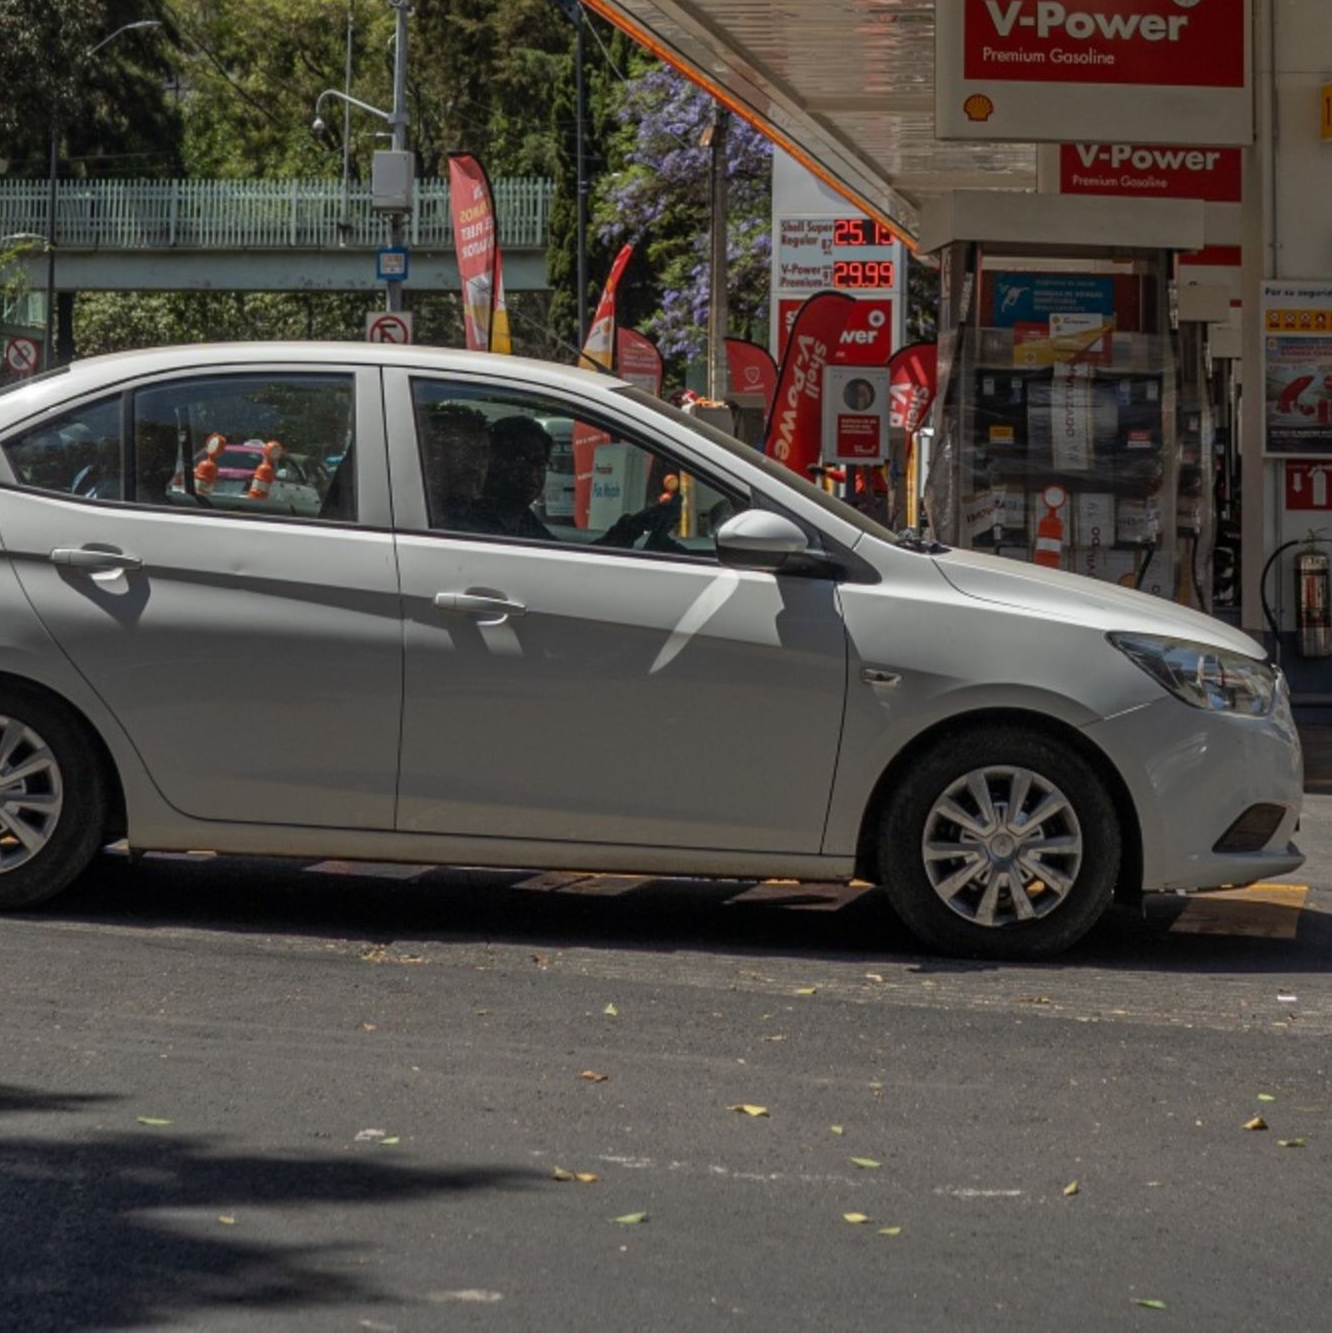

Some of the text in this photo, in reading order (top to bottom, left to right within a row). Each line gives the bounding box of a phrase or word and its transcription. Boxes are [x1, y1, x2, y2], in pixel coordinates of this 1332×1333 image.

[984, 0, 1188, 41] V-Power
[983, 47, 1114, 65] Premium Gasoline
[1075, 144, 1220, 171] V-Power
[1072, 174, 1168, 189] Premium Gasoline
[780, 220, 805, 232] Shell
[807, 220, 833, 235] Super
[781, 233, 818, 248] Regular
[780, 277, 823, 287] Premium
[781, 262, 894, 287] V-Power 29.99
[1265, 287, 1281, 297] Por
[804, 341, 827, 400] Shell
[773, 334, 815, 461] V-Powe
